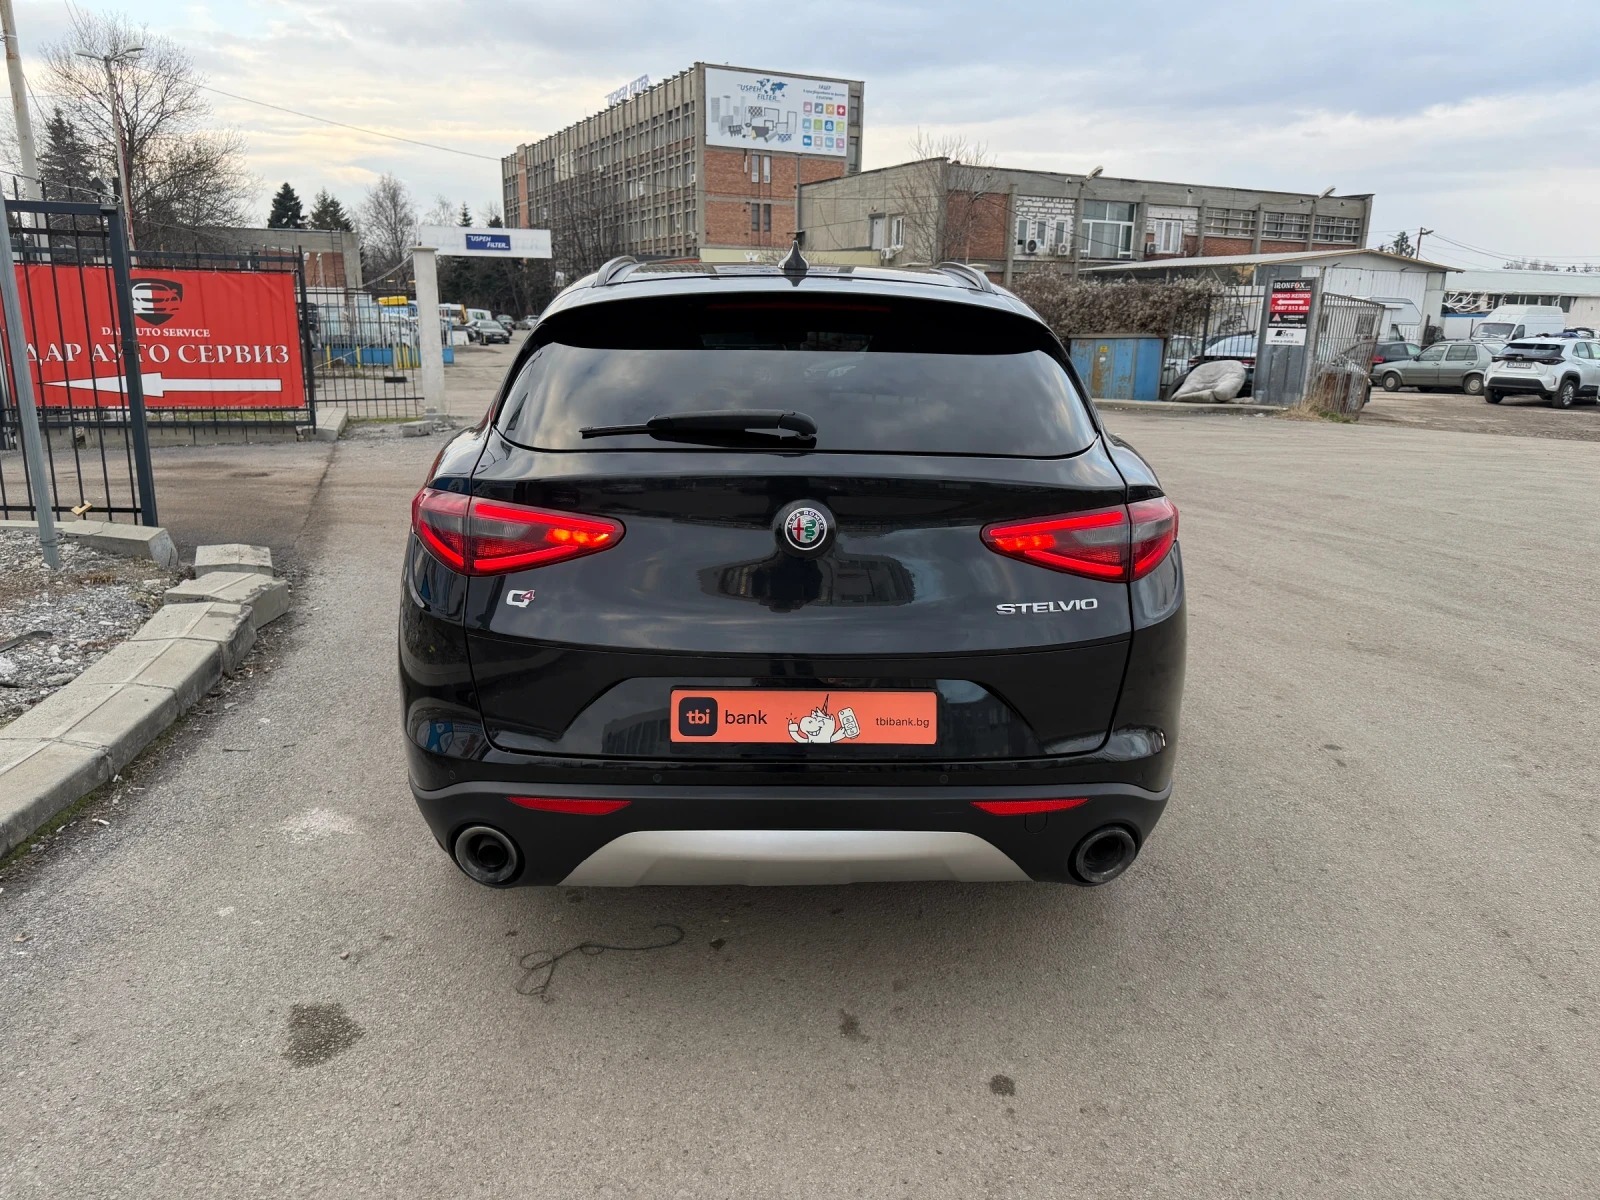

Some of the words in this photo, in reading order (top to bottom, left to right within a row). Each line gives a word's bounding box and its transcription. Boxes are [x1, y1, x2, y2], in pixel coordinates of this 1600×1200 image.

[740, 84, 761, 93] USPEH
[757, 94, 778, 102] FILTER
[162, 328, 211, 338] SERVICE
[178, 344, 290, 364] СЕРВИЗ
[506, 589, 536, 608] Q4
[996, 598, 1098, 615] STELVIO
[686, 708, 710, 725] tbi
[724, 709, 768, 725] bank
[875, 716, 930, 728] tbibank.bg
